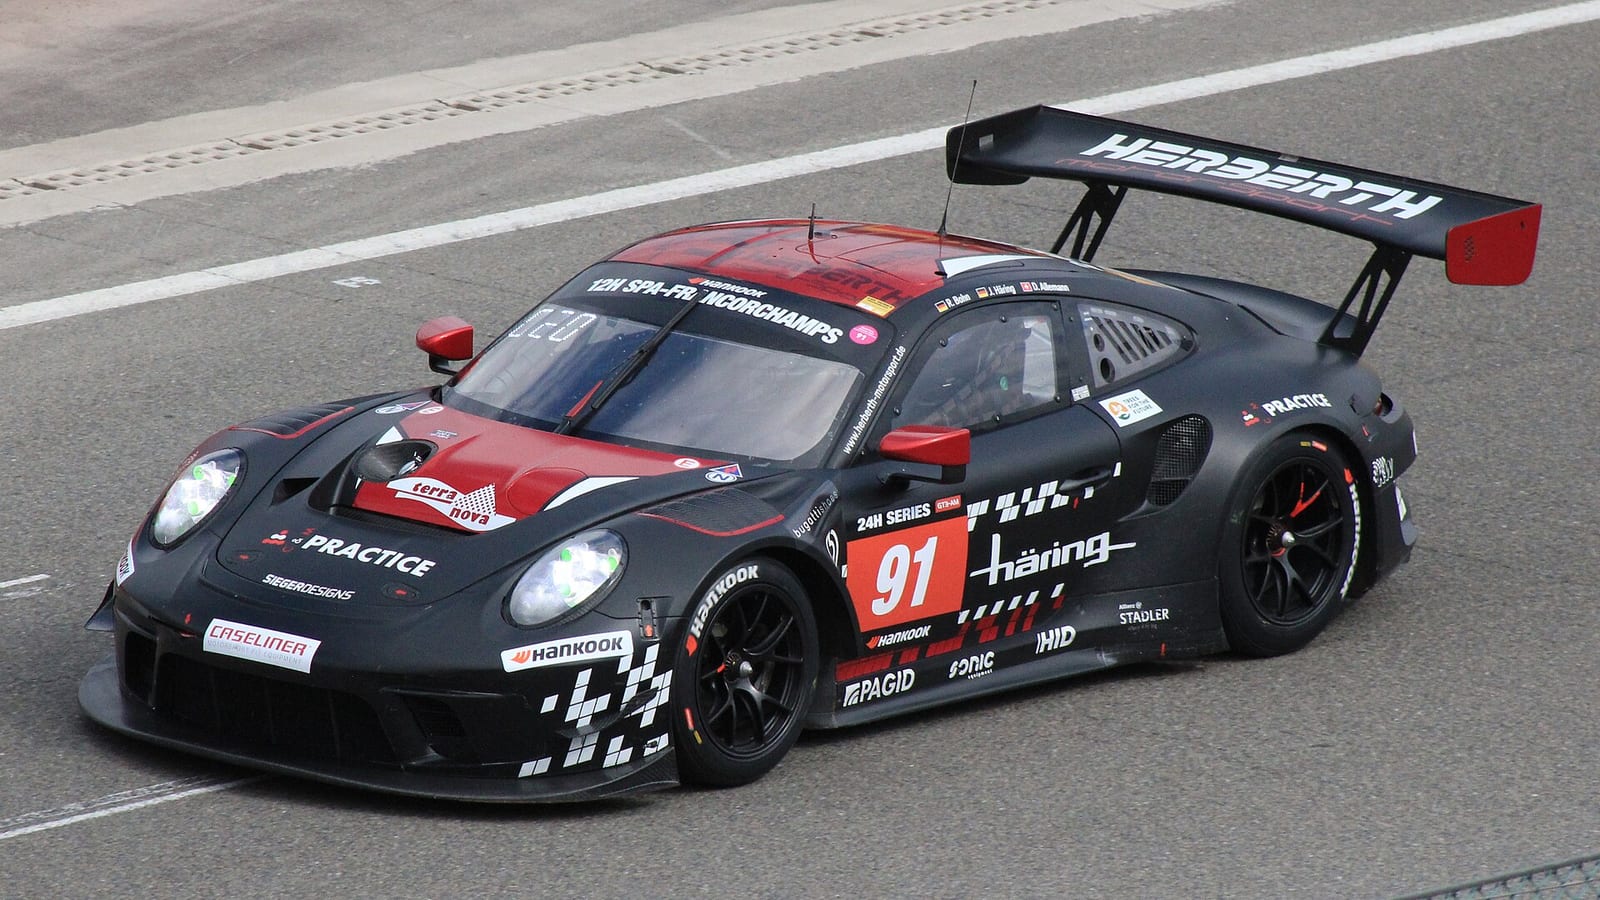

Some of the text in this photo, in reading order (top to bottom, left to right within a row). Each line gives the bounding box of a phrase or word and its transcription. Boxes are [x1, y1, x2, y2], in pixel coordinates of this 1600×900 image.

[1079, 134, 1443, 220] HERBERTH
[587, 278, 624, 293] 12H
[843, 345, 906, 455] www.herberth-motorsport.de
[1262, 393, 1332, 417] PRACTICE
[412, 482, 458, 500] terra
[449, 506, 490, 525] nova
[857, 503, 931, 532] 24H SERIES
[301, 534, 437, 577] PRACTICE
[969, 531, 1136, 586] häring
[262, 573, 355, 600] SIEGERDESIGNS
[871, 535, 938, 616] 91
[1120, 608, 1170, 625] STADLER
[209, 625, 308, 656] CASELINER
[859, 668, 916, 703] PAGID
